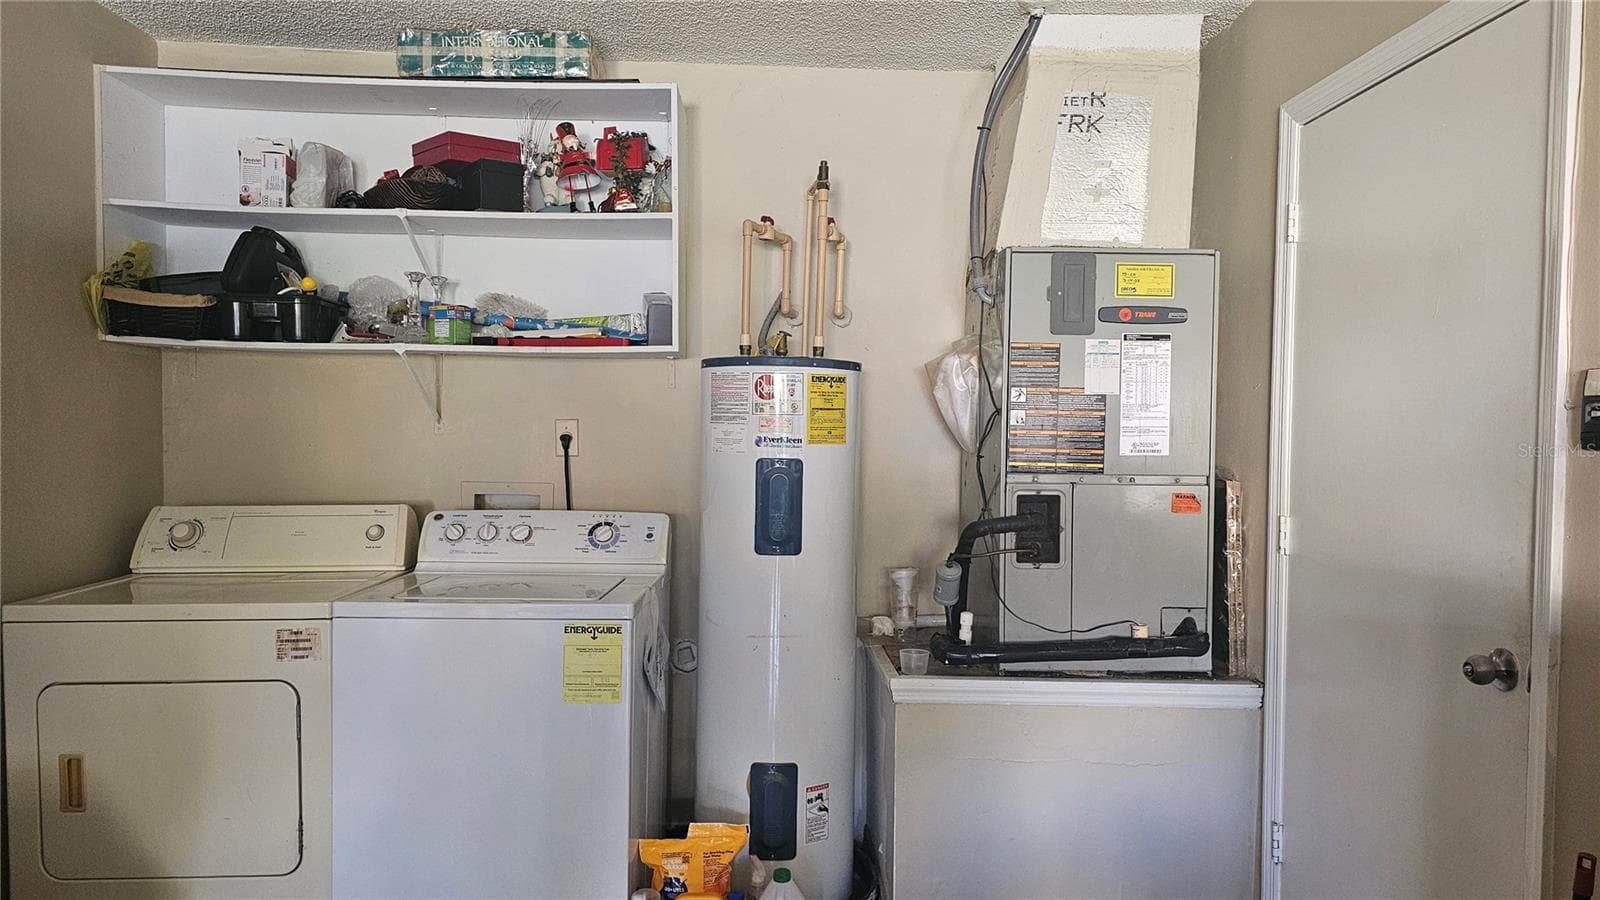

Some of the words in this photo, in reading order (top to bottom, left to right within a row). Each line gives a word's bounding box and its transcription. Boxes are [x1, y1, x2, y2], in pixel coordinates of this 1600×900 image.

[441, 35, 544, 48] INTERNTIONAL
[811, 375, 847, 385] ENERGYGUIDE
[564, 625, 623, 635] ENERGYGUIDE
